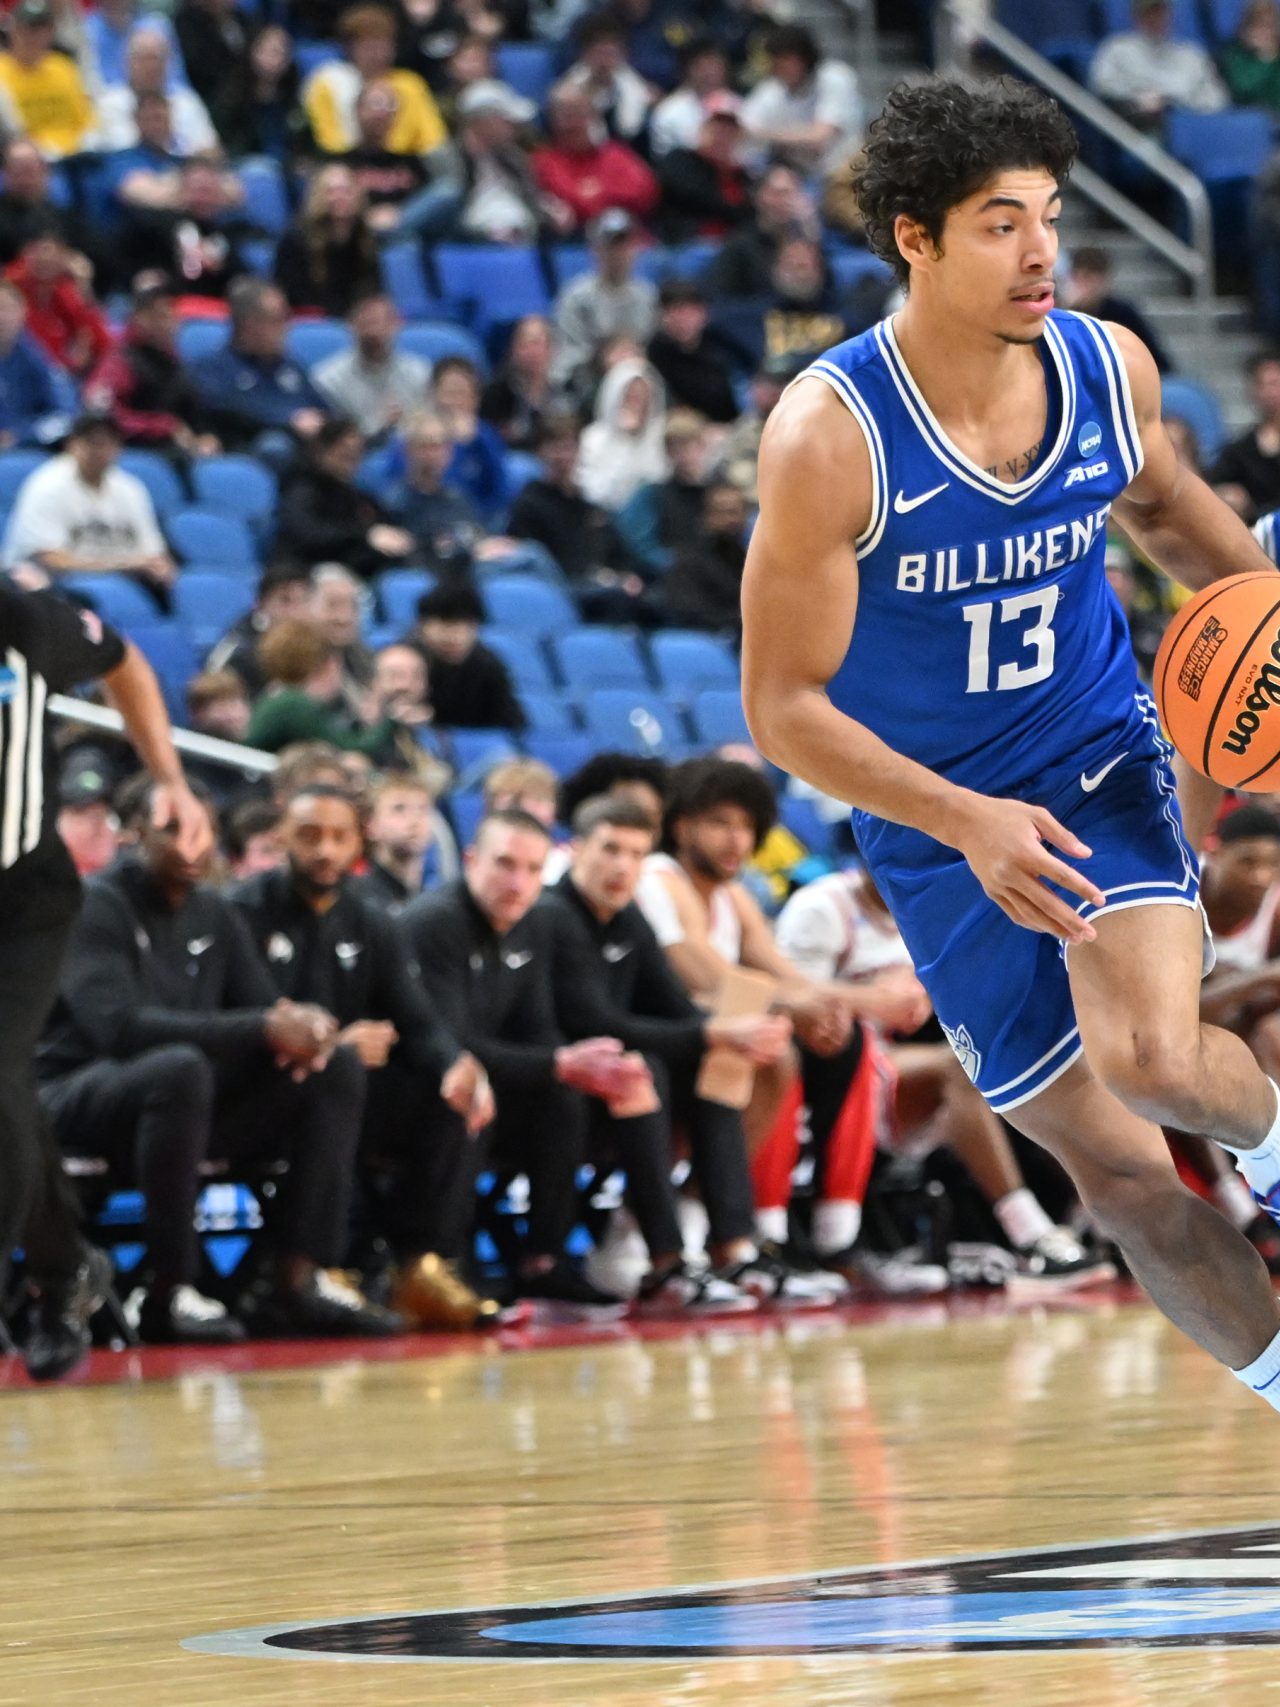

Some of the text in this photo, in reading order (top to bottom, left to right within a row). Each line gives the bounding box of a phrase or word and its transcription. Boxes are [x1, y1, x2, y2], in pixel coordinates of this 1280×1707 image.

[962, 584, 1059, 693] 13
[1194, 637, 1220, 681] MARCH
[1179, 637, 1208, 692] MADNESS
[1235, 664, 1258, 706] EVO NXT
